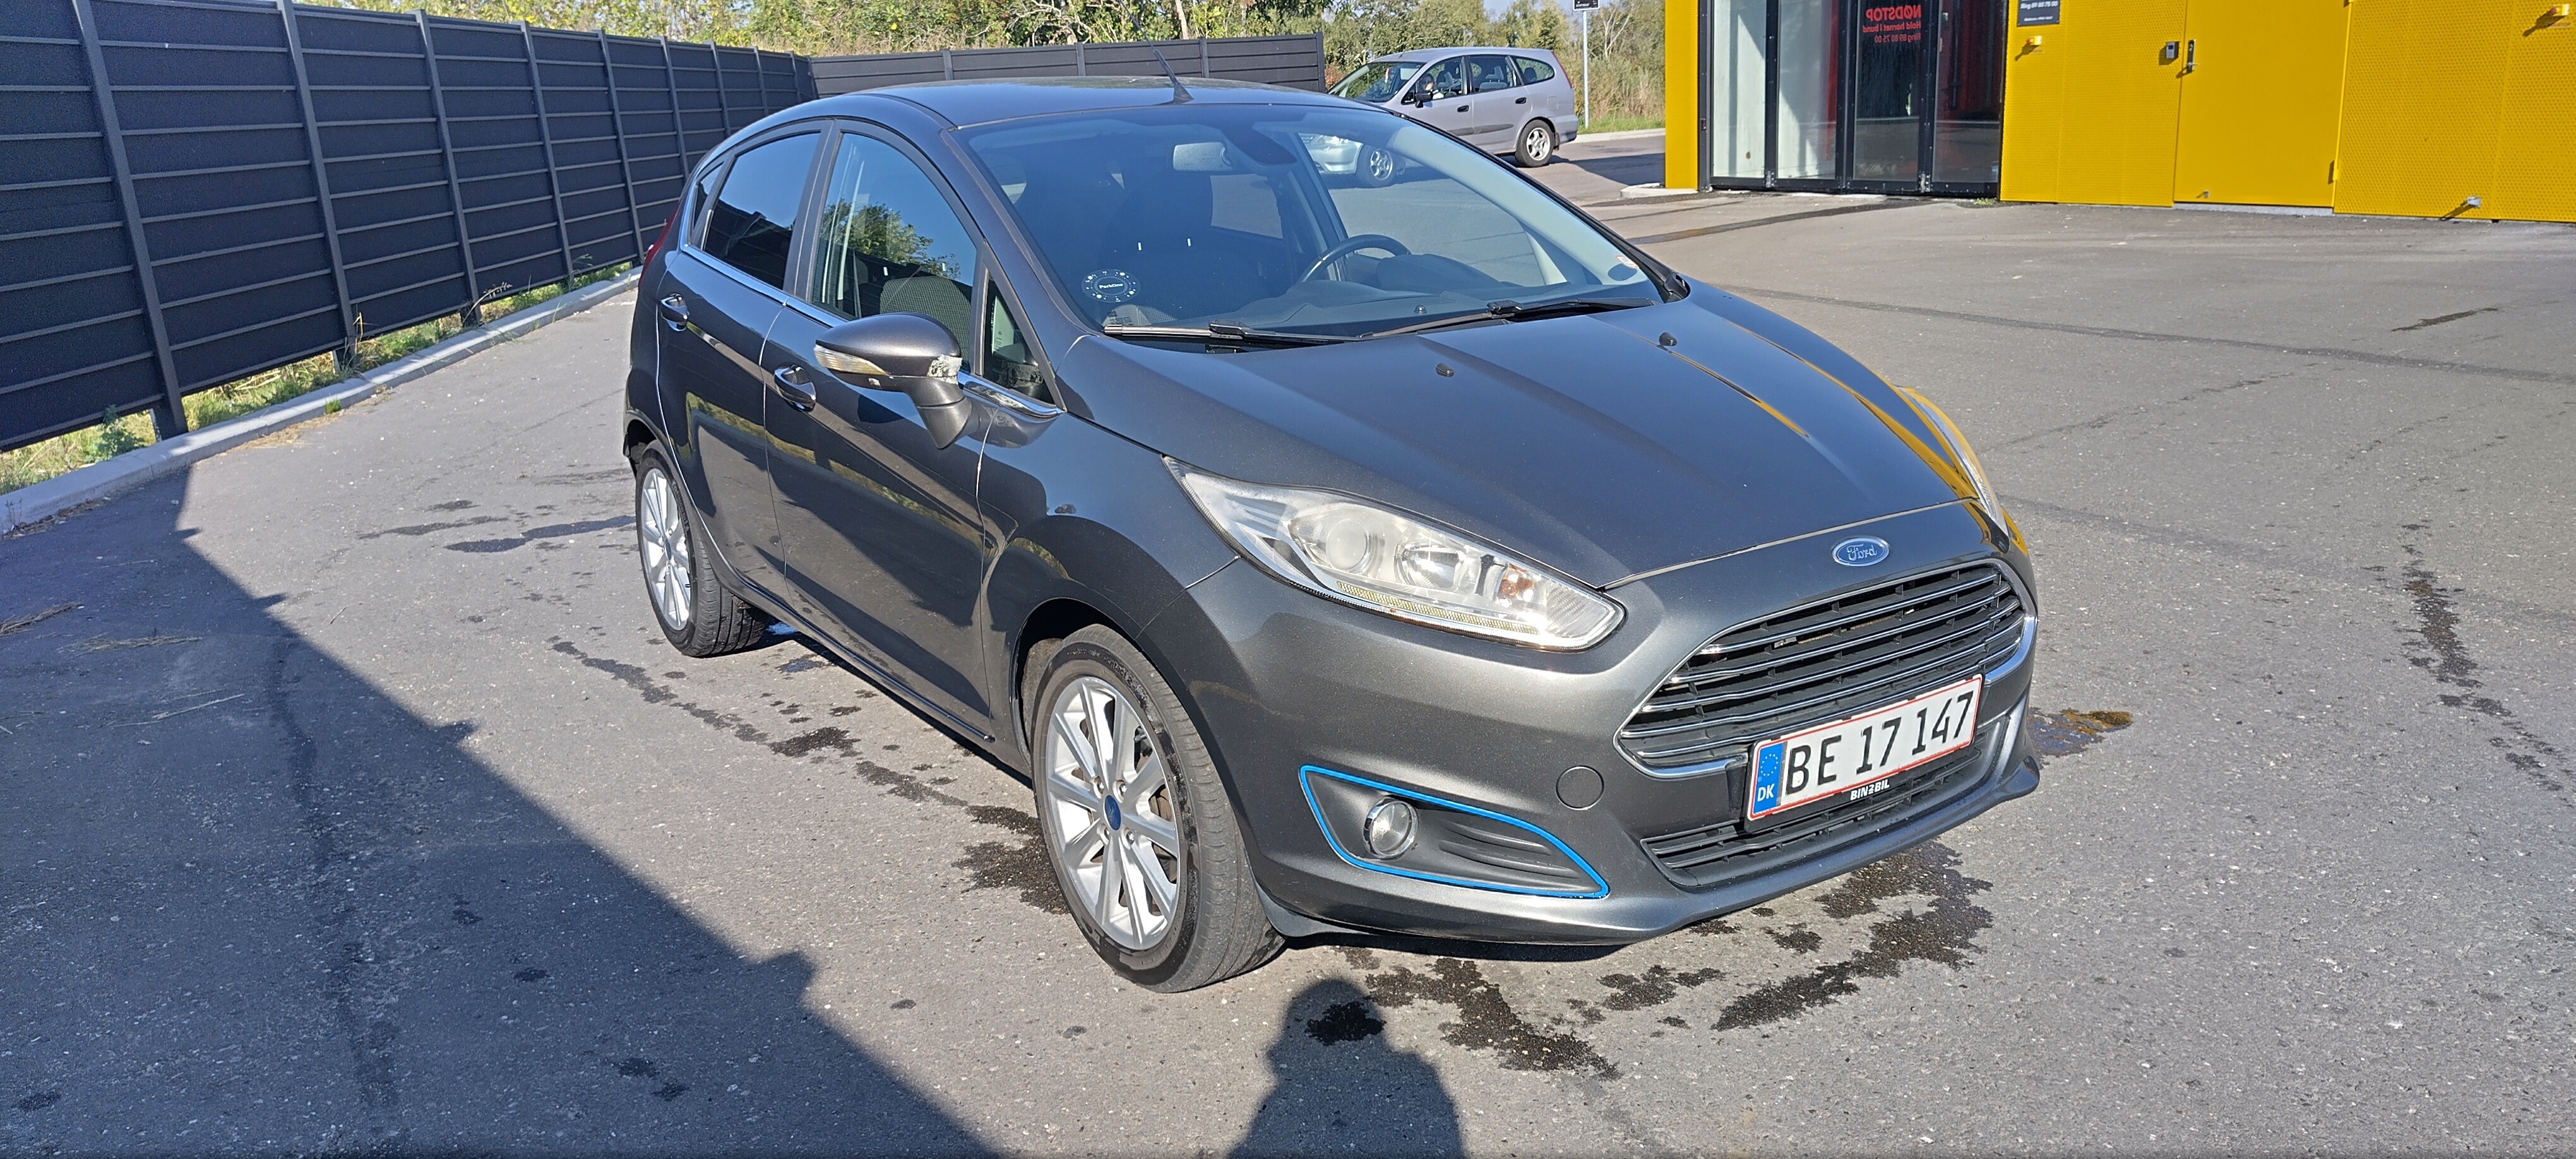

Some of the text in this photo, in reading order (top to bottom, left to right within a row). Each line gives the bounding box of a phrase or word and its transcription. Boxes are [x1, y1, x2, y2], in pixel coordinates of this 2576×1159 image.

[1846, 544, 1877, 561] Ford
[1786, 690, 1974, 795] BE 17 147
[1757, 783, 1774, 802] DK
[1850, 779, 1890, 800] BIN2BIL
